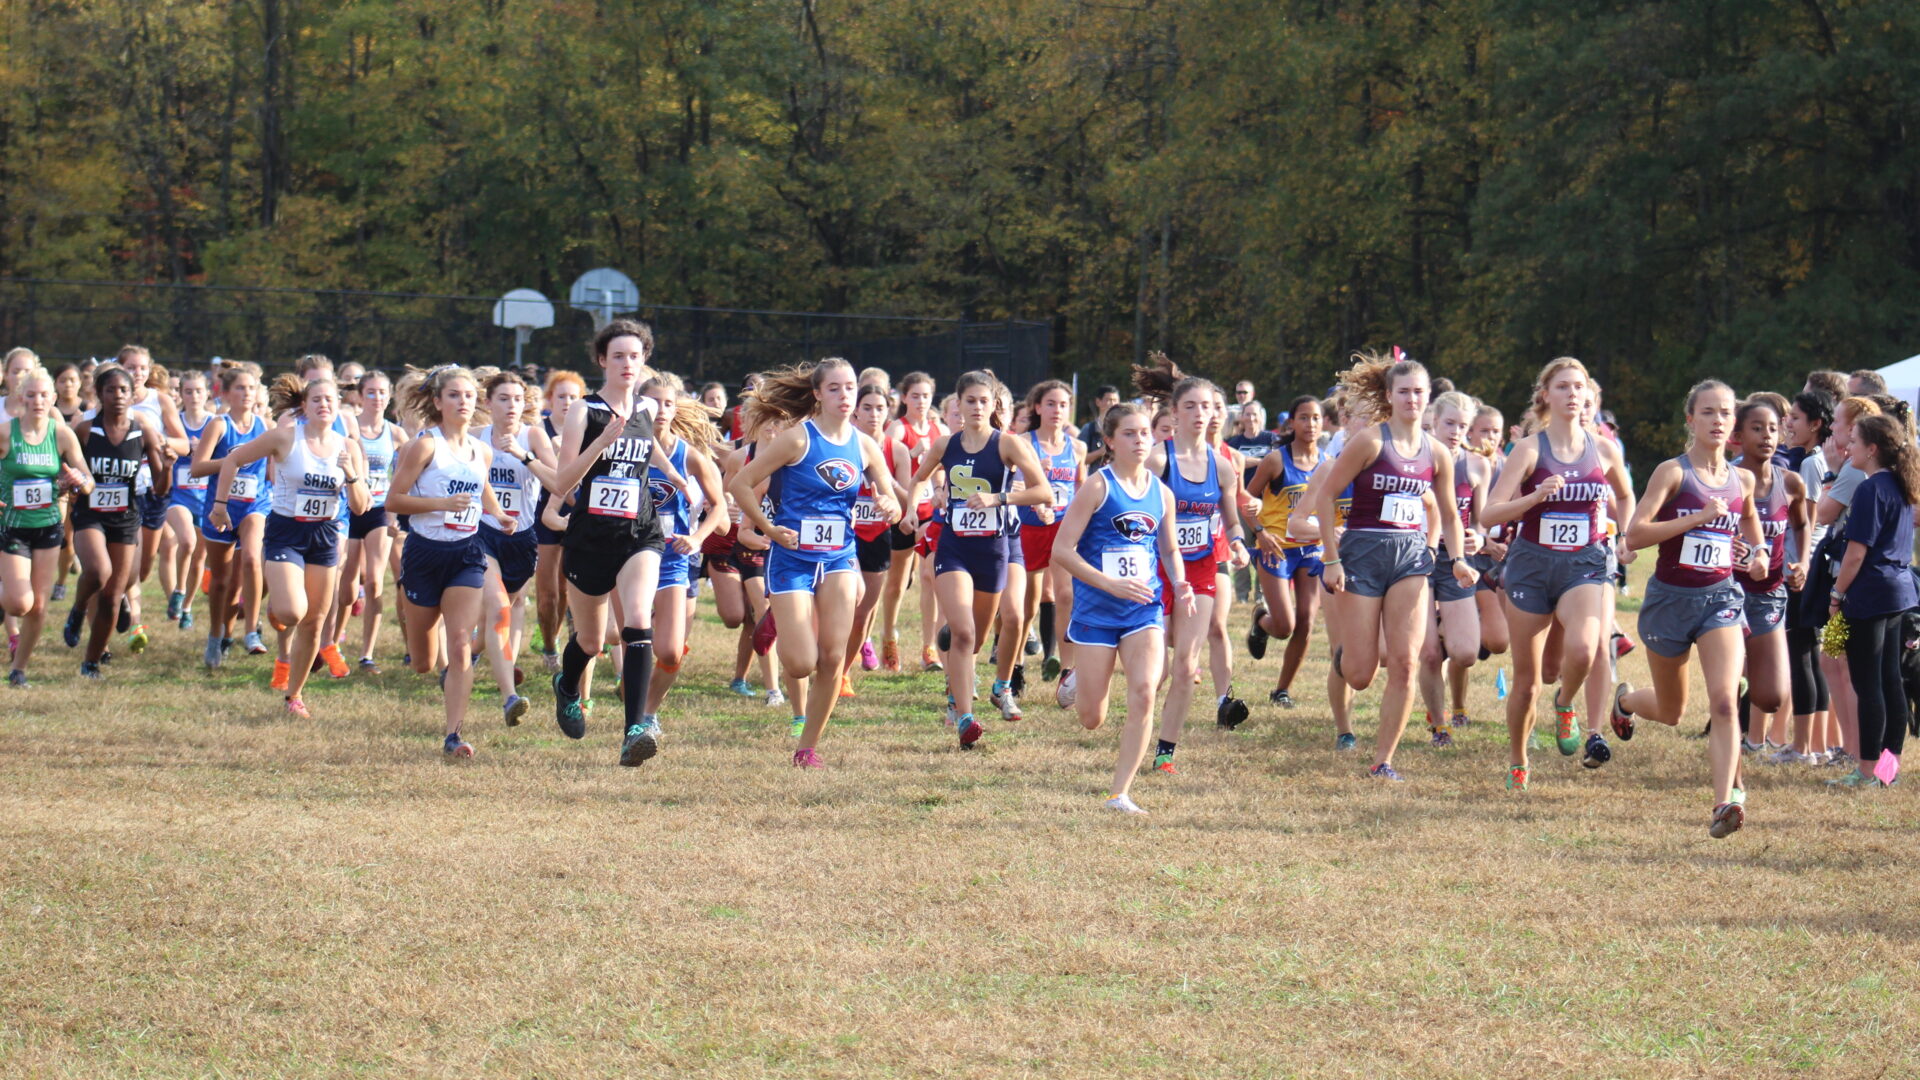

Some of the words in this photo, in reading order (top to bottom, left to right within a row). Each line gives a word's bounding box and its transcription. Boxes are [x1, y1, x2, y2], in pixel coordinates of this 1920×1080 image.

[602, 437, 652, 462] MEADE
[16, 452, 54, 466] ARUNDEL
[90, 457, 139, 477] MEADE
[304, 472, 337, 490] SRHS
[489, 467, 515, 483] RHS
[25, 488, 41, 504] 63
[230, 480, 246, 495] 33
[97, 491, 121, 506] 275
[599, 487, 630, 509] 272
[302, 499, 328, 516] 491
[855, 504, 877, 519] 304
[959, 511, 987, 529] 422
[814, 524, 833, 543] 34
[1178, 526, 1202, 545] 336
[1550, 524, 1578, 544] 123
[1694, 543, 1721, 566] 103
[1118, 556, 1138, 577] 35
